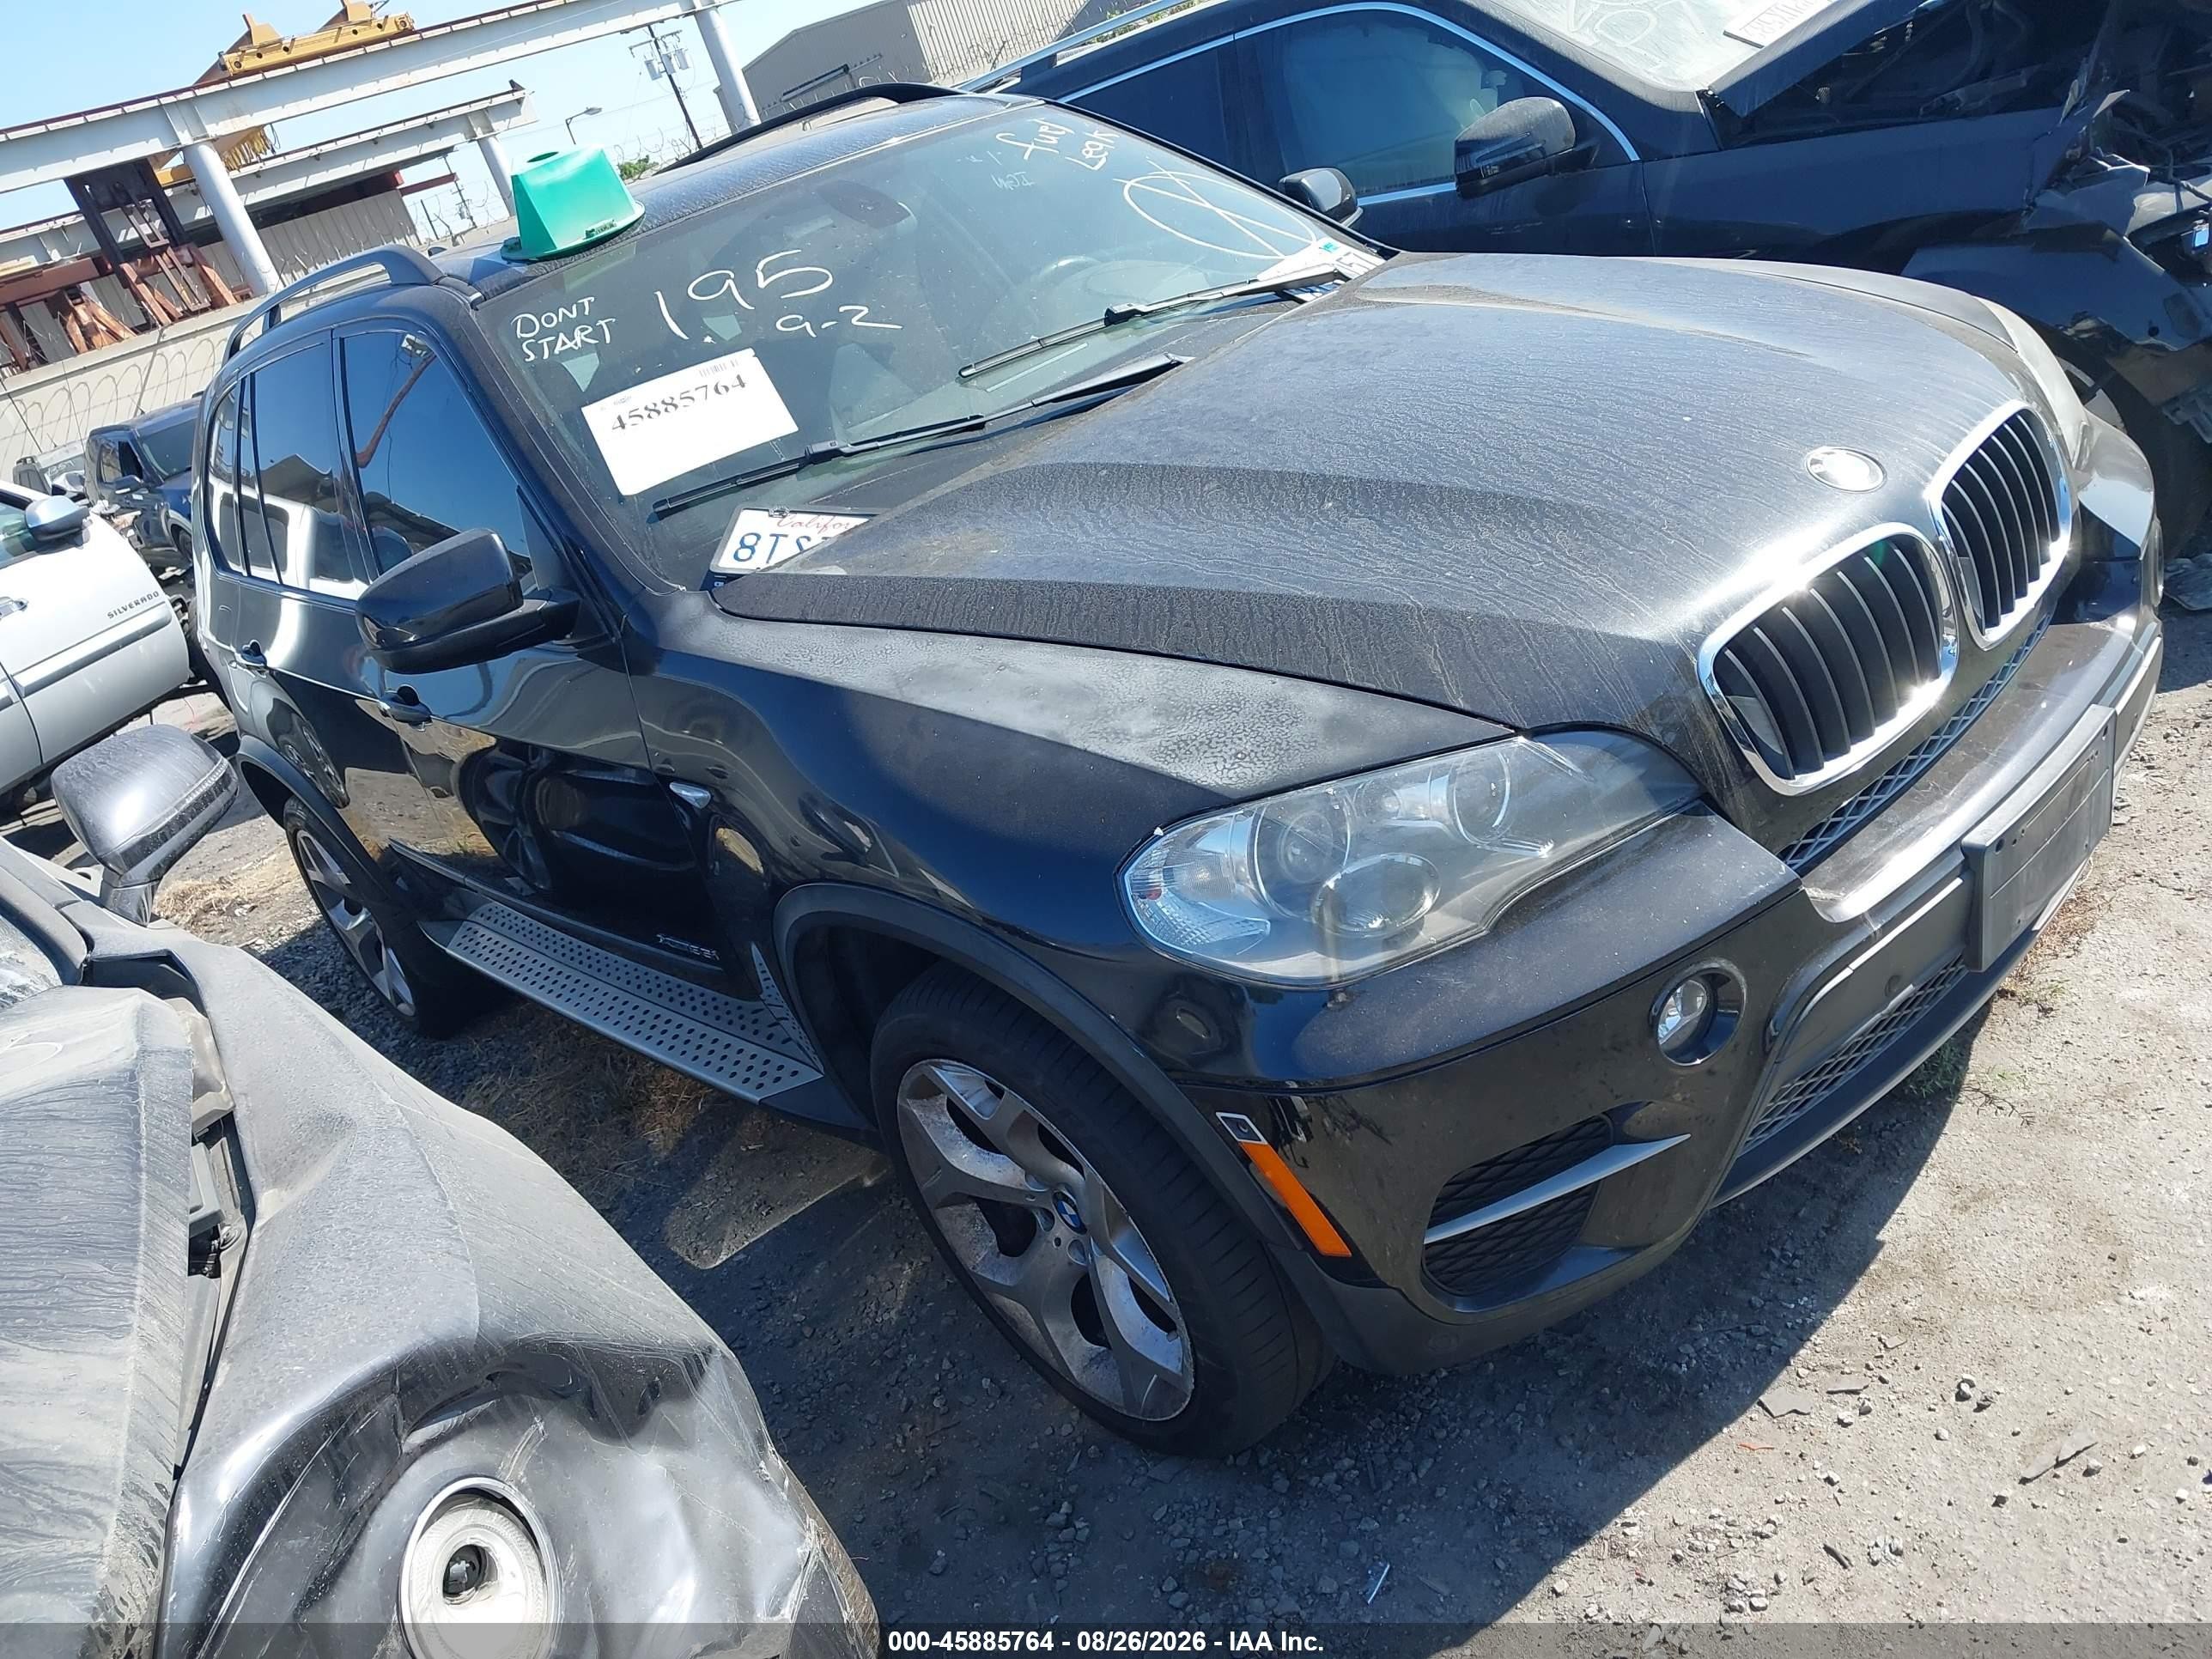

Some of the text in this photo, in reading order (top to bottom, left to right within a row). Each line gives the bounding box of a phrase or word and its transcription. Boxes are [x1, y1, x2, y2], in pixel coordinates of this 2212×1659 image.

[510, 296, 595, 339] DONT
[521, 318, 617, 362] START
[611, 374, 747, 430] 45885764
[106, 591, 160, 619] SILVERADO
